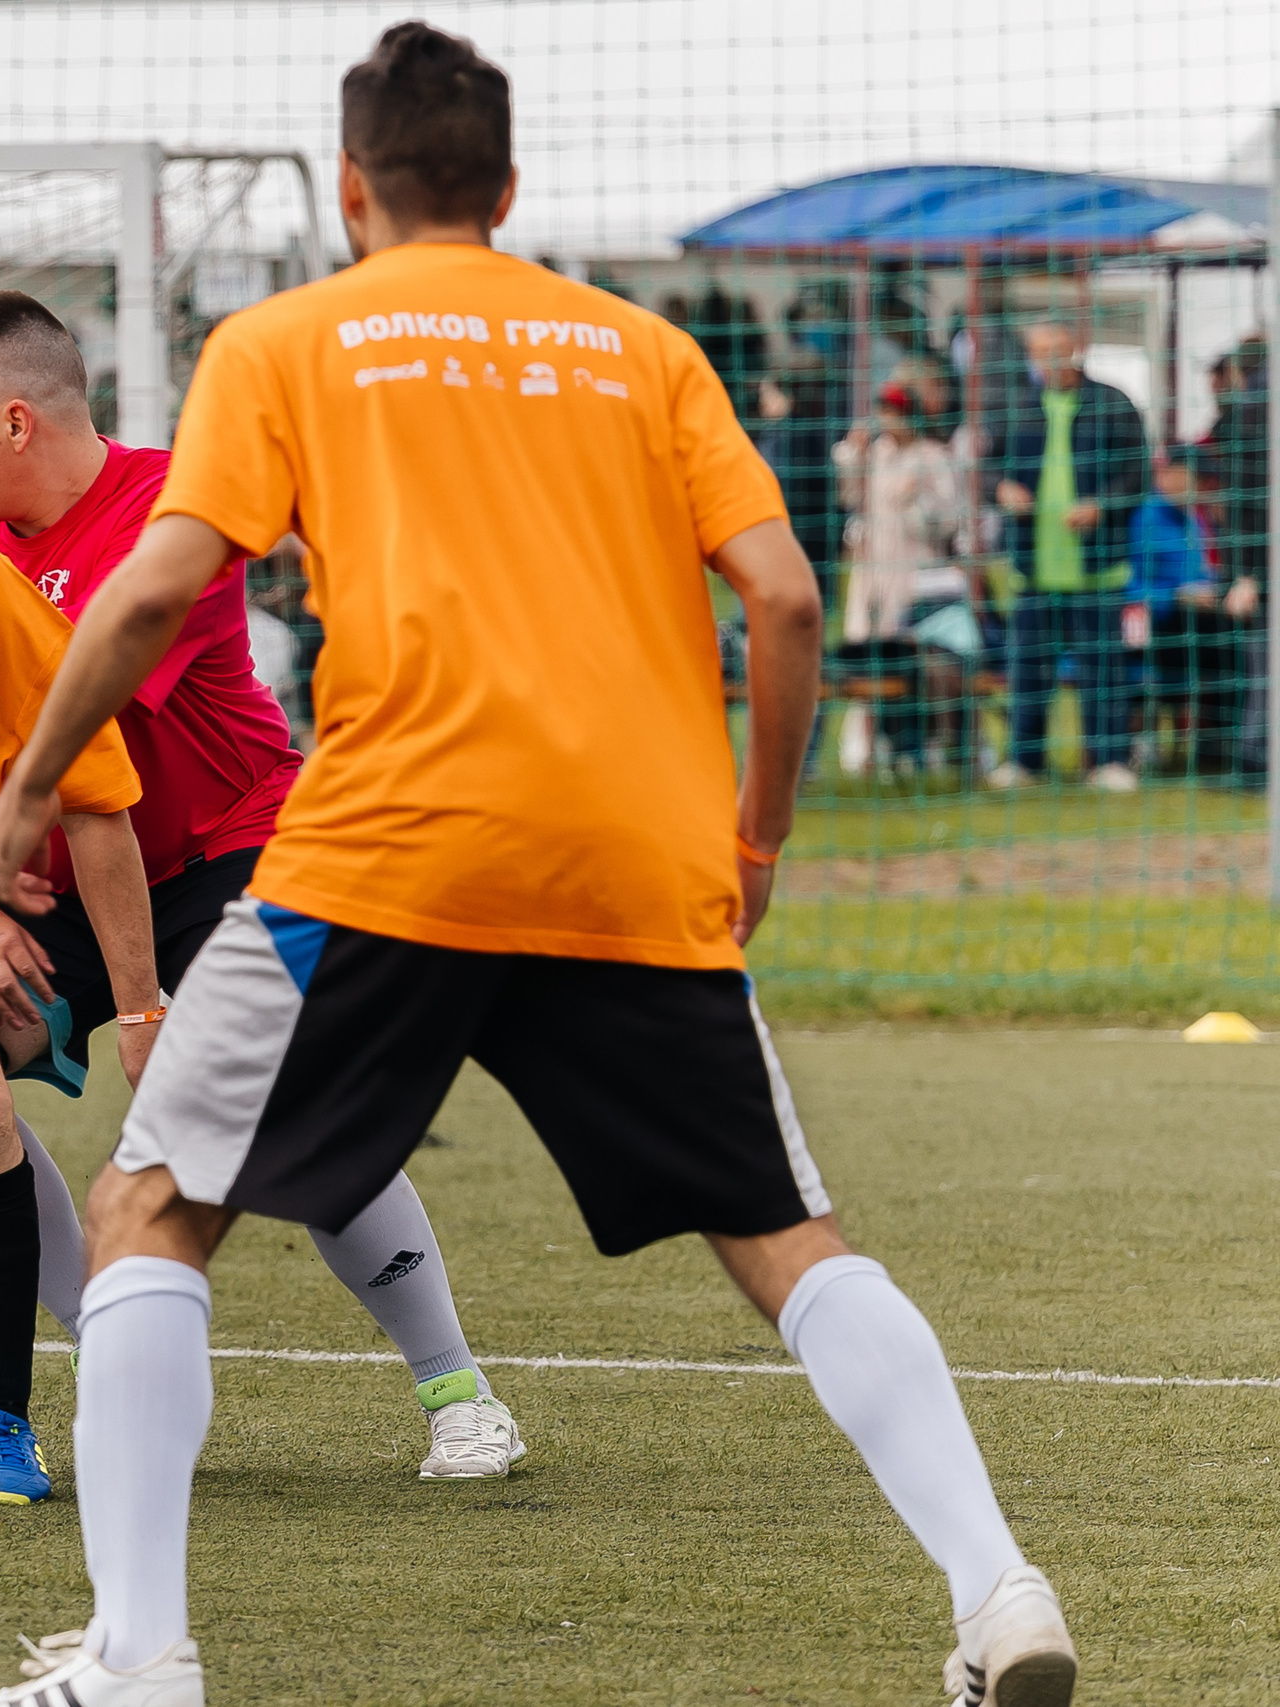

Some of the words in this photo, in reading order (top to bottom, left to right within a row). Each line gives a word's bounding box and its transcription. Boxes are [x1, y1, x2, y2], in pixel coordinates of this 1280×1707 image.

[337, 311, 491, 350] ВОЛКОВ
[503, 319, 623, 356] ГРУПП
[367, 1250, 426, 1288] adidas
